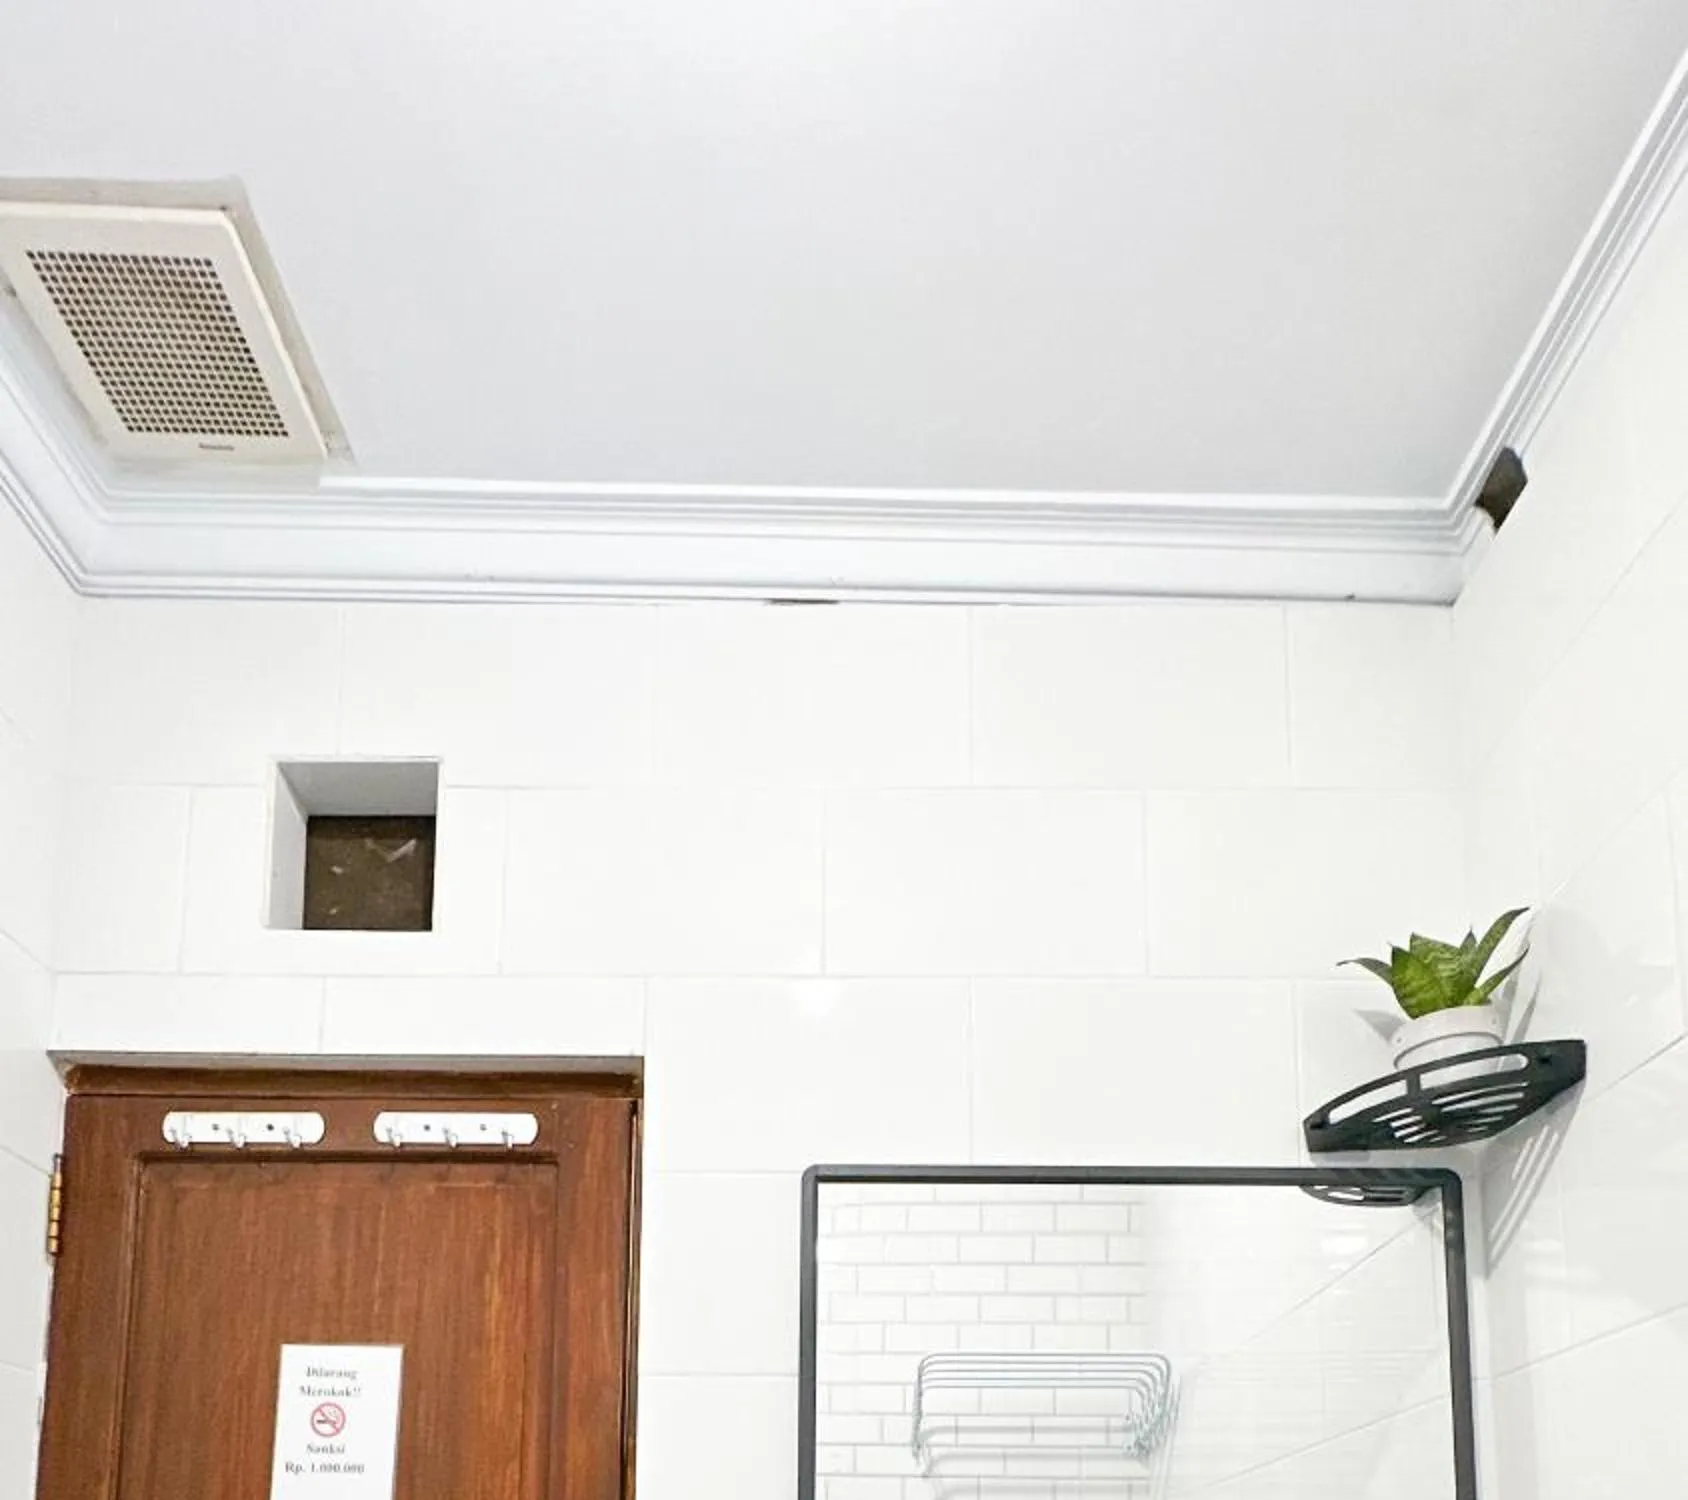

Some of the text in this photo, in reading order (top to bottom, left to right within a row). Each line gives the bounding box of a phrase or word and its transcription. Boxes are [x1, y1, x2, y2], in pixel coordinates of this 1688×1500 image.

[306, 1366, 358, 1380] Dilarang
[306, 1444, 346, 1454] Sanksi
[285, 1462, 365, 1475] Rp. 1.000.000
